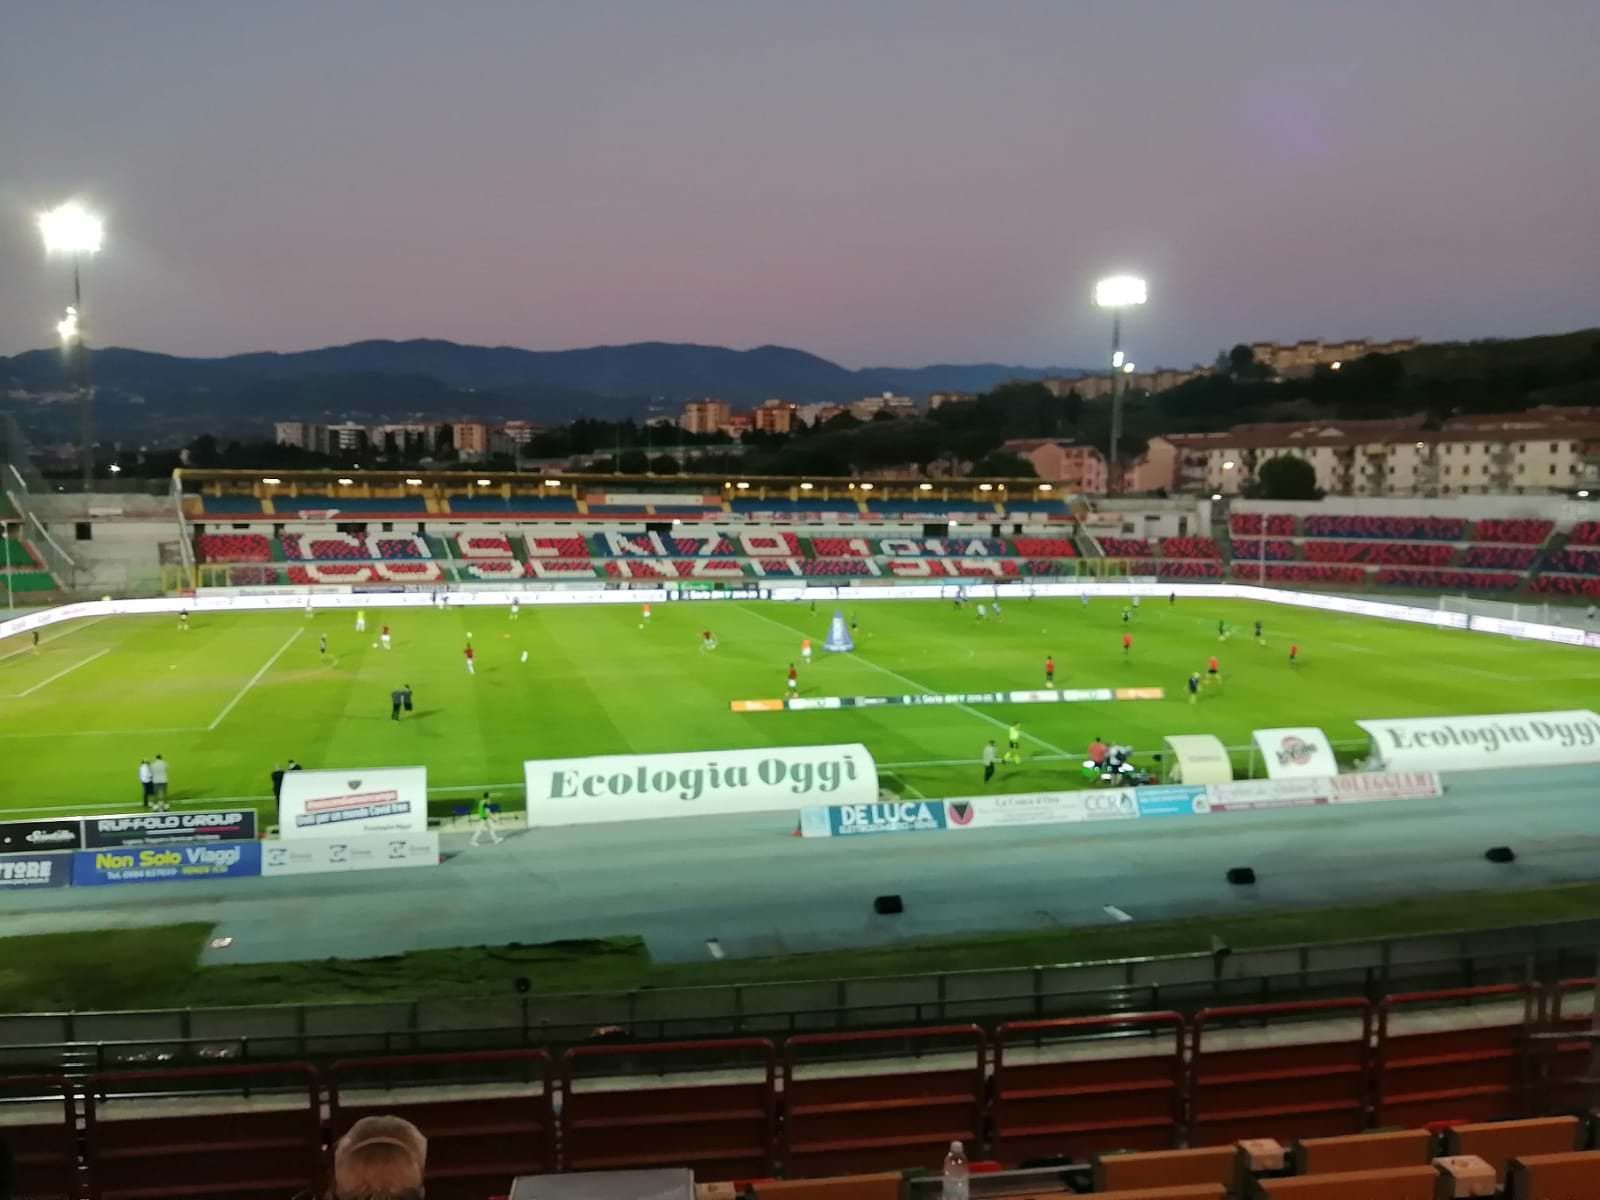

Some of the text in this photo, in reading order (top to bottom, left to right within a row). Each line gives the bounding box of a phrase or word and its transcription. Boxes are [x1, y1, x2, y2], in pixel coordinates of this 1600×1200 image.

[300, 531, 803, 582] COSENZA
[1385, 717, 1600, 752] Ecologia Oggi
[547, 754, 858, 801] Ecologia Oggi
[182, 812, 243, 827] GROUP
[841, 801, 934, 825] DE LUCA
[0, 860, 52, 879] TORE
[95, 846, 241, 869] Non Solo Viaggi
